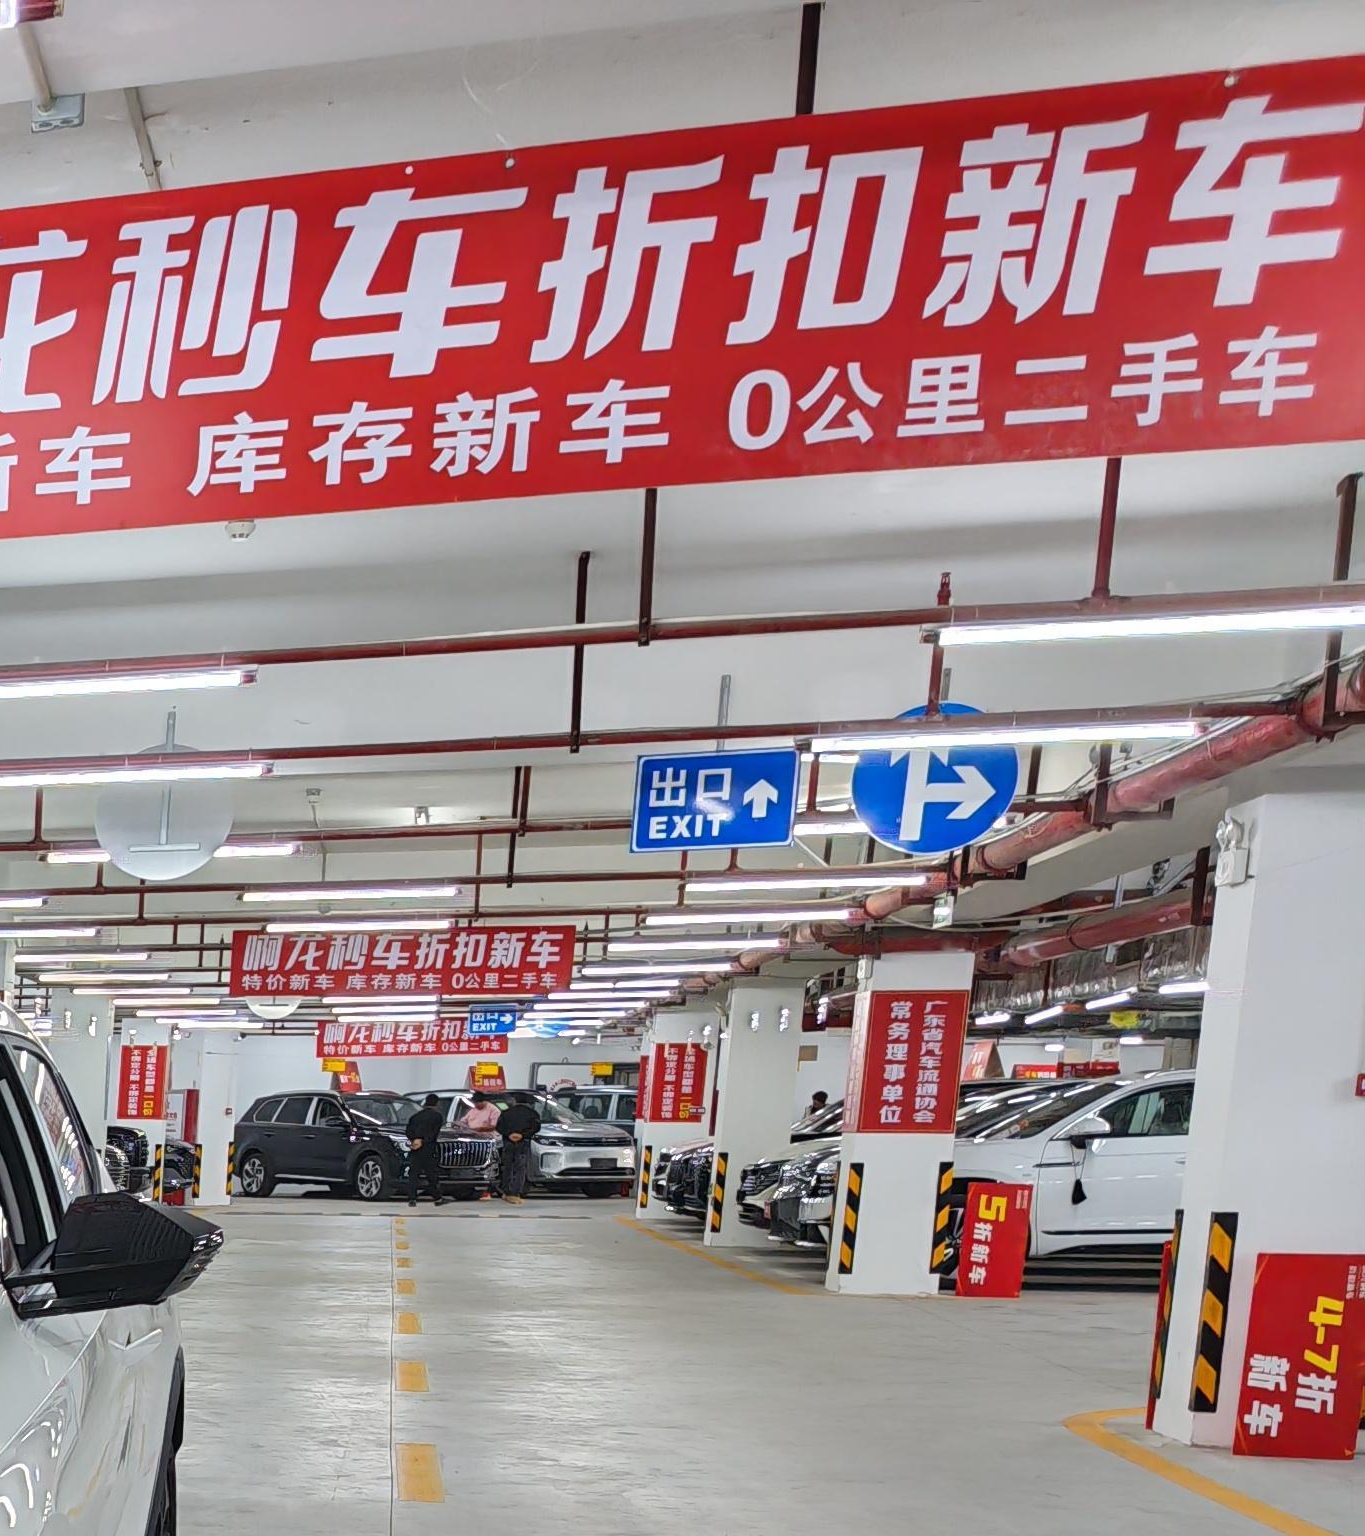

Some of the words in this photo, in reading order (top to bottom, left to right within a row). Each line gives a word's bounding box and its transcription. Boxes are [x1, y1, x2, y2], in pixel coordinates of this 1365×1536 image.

[186, 379, 671, 498] 库存新车
[726, 325, 1318, 451] 0公里二手车
[648, 766, 733, 808] 出口
[648, 813, 729, 840] EXIT
[241, 973, 335, 991] 特价新车
[346, 973, 442, 990] 库存新车
[452, 971, 558, 989] 0公里二手车
[242, 931, 564, 971] 啊龙秒车折扣新车
[324, 1019, 497, 1044] 啊龙秒车折扣
[472, 1022, 498, 1032] EXIT
[879, 1000, 914, 1124] 常务理事单位
[912, 1000, 949, 1124] 广东省汽车流通协会
[968, 1193, 1008, 1286] 5折新车
[1294, 1295, 1345, 1415] 4-7折
[1243, 1353, 1291, 1438] 新车
